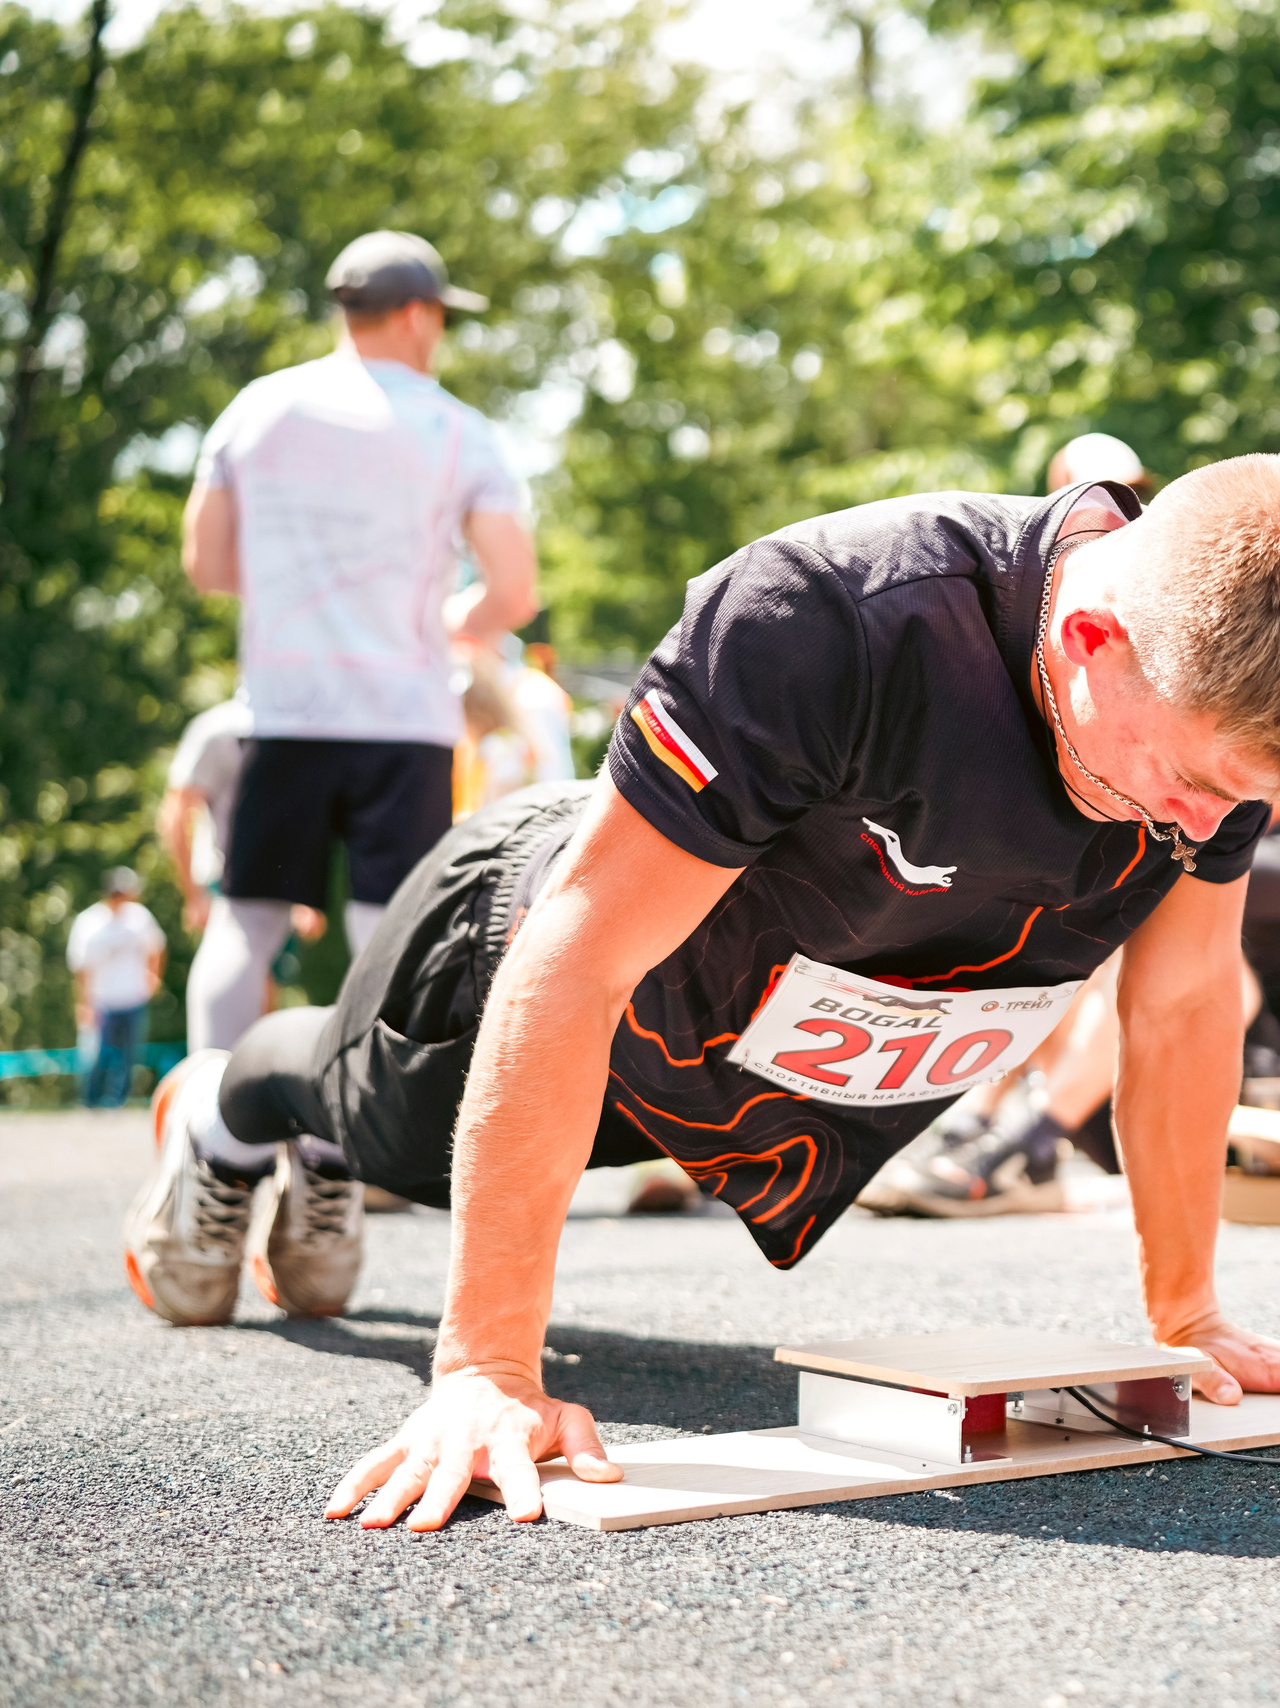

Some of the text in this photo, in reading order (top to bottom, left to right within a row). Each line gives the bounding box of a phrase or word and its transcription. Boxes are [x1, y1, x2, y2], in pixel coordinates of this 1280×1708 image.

[860, 832, 950, 896] СПОРТИВНЫЙ МАРАФОН
[809, 996, 943, 1028] BOGAL
[771, 1017, 1014, 1090] 210
[754, 1061, 867, 1101] СПОРТИВНЫЙ
[872, 1085, 952, 1101] МАРАФОН
